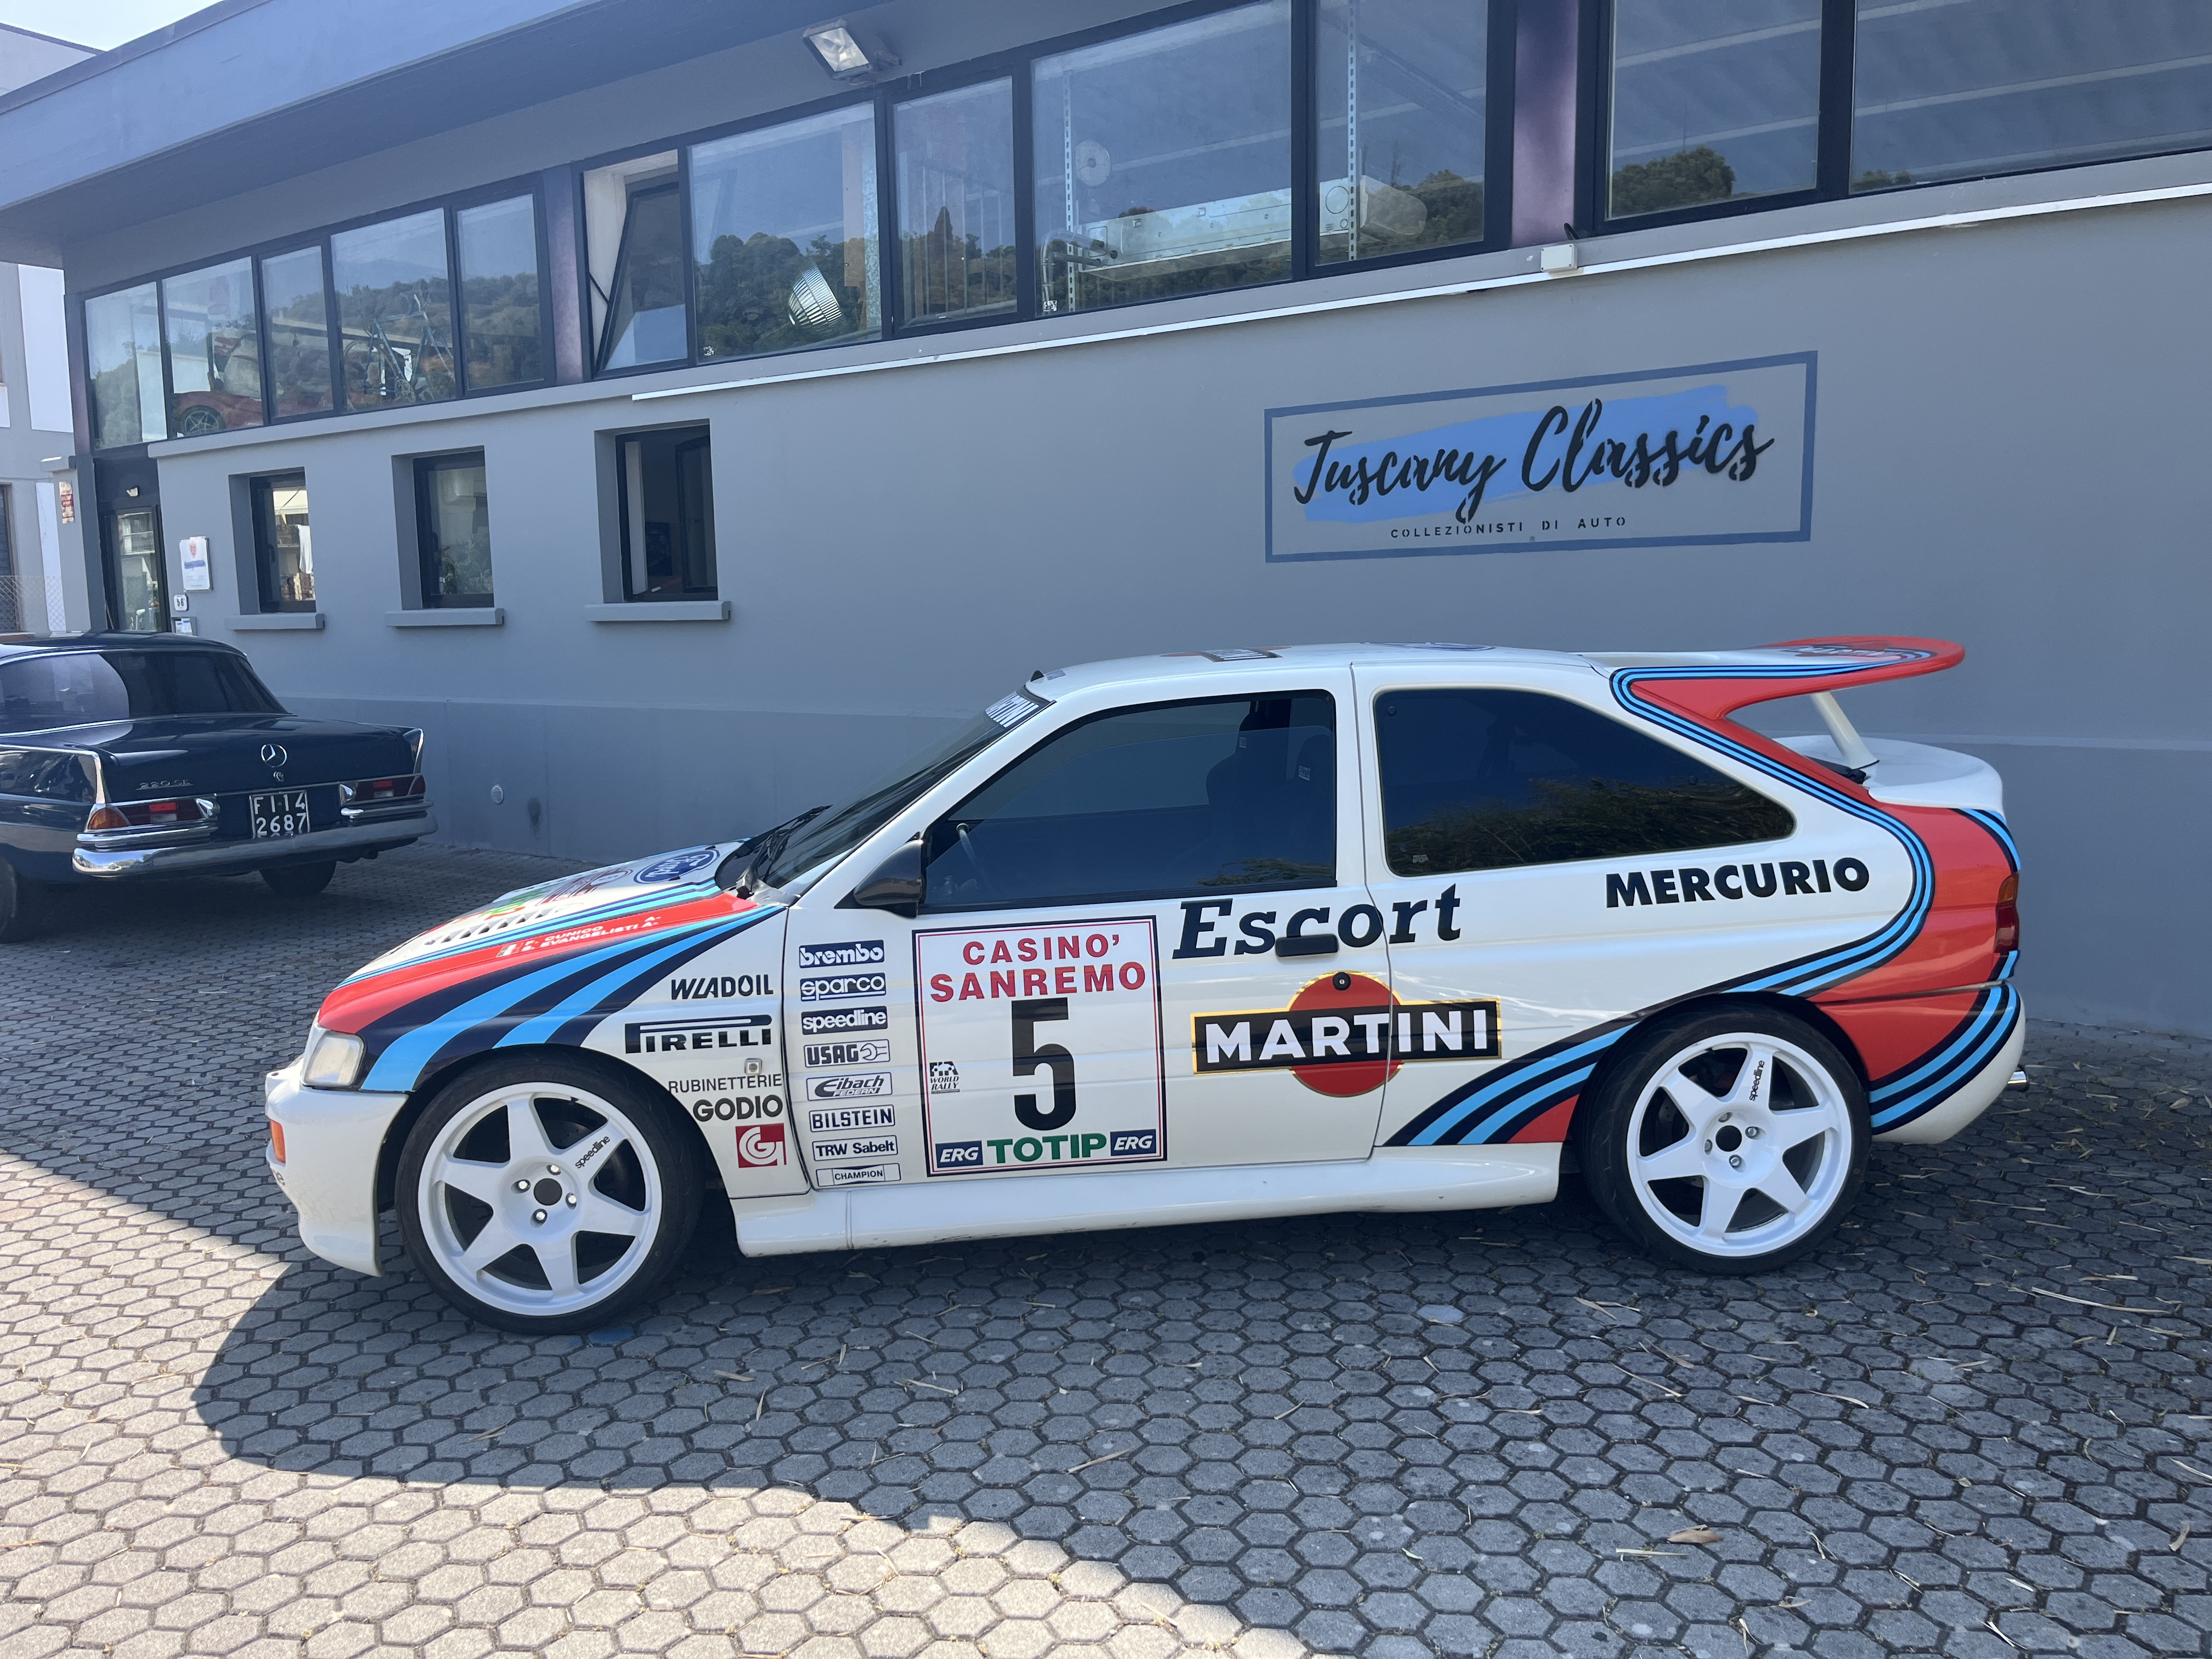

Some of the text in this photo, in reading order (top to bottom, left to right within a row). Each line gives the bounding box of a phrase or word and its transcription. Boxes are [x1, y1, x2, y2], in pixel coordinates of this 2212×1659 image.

[1294, 398, 1774, 523] Tuscany Classics
[1391, 517, 1626, 538] COLLEZIONISTI DI AUTO
[256, 812, 307, 834] 2687
[645, 854, 710, 878] Ford
[1606, 857, 1869, 908] MERCURIO
[545, 926, 603, 941] CUNICO
[1172, 883, 1461, 960] Escort
[540, 924, 638, 948] EVANGELISTI
[799, 944, 884, 966] brembo
[801, 975, 885, 999] sparco
[930, 961, 1146, 1002] SANREMO
[803, 1009, 887, 1033] speedline
[625, 1014, 772, 1054] PIRELLI
[1205, 1009, 1487, 1063] MARTINI
[807, 1044, 859, 1065] USAG
[1011, 997, 1076, 1131] 5
[668, 1074, 782, 1093] RUBINETTERIE
[815, 1075, 884, 1097] Eibach
[833, 1088, 878, 1097] FEDERN
[932, 1082, 959, 1091] RALLY
[693, 1094, 783, 1121] GODIO
[812, 1108, 893, 1129] BILSTEIN
[815, 1140, 895, 1156] TRW Sabelt
[940, 1132, 1153, 1164] ERG TOTIP ERG
[834, 1170, 883, 1180] CHAMPION
